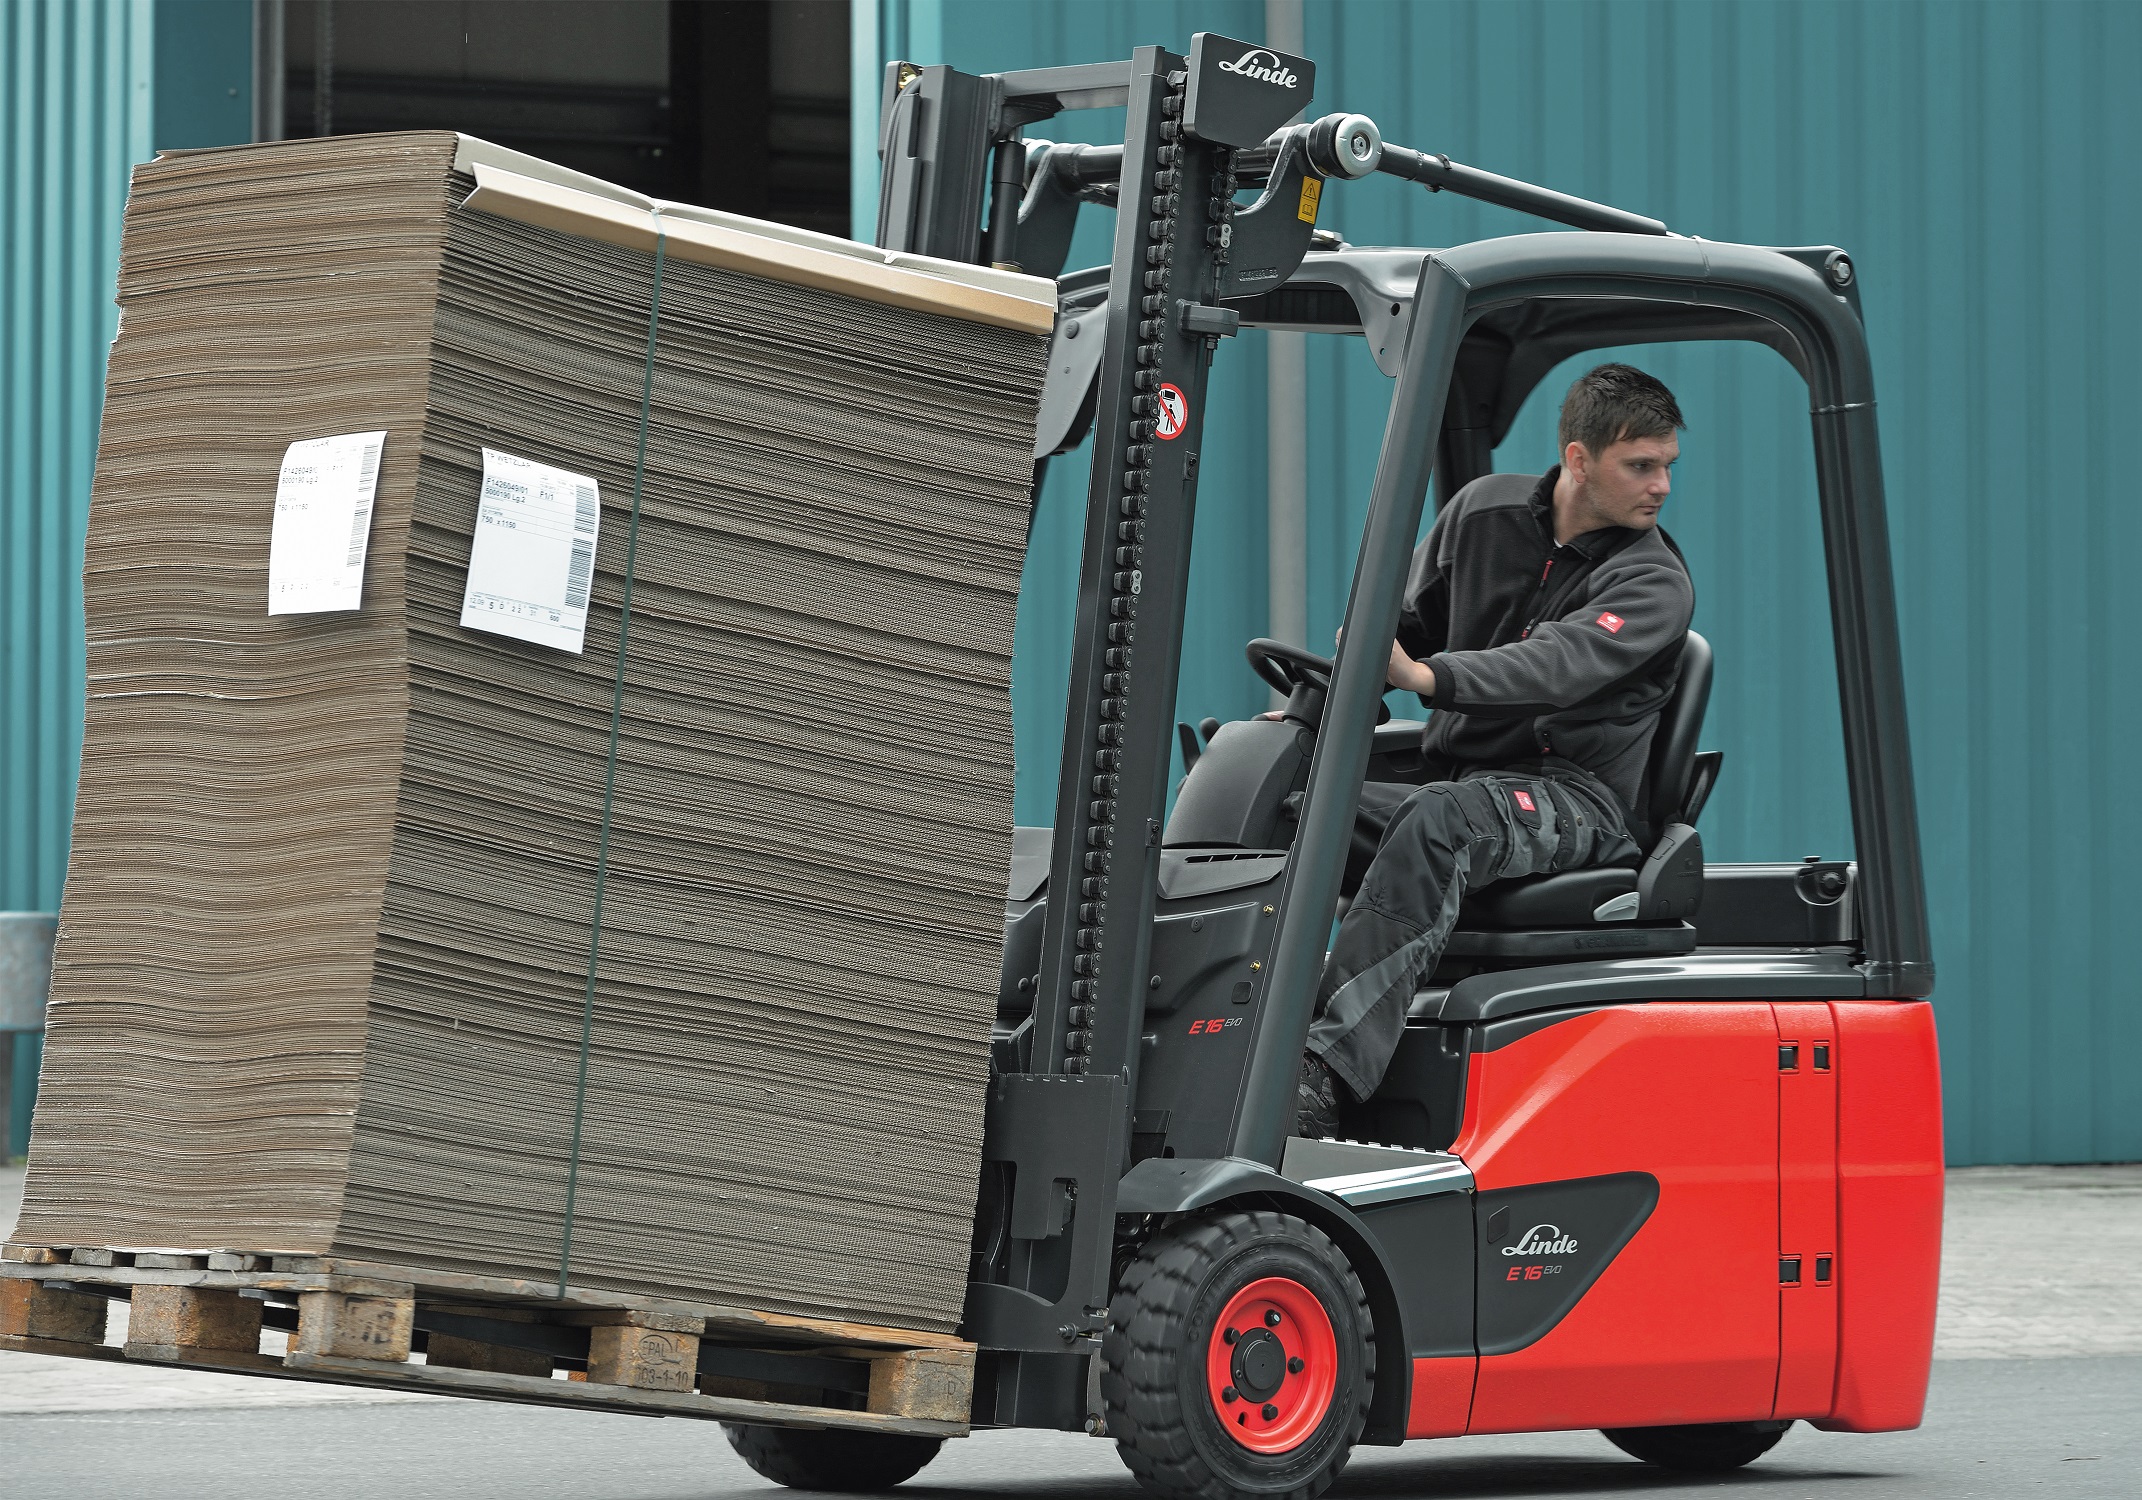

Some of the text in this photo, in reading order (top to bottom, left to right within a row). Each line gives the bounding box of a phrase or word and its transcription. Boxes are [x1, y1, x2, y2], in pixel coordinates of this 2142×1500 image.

[1218, 49, 1298, 88] Linde
[1188, 1017, 1243, 1035] E 16 EVO
[1501, 1224, 1578, 1256] Linde
[1506, 1265, 1562, 1281] E 16 EVO
[642, 1340, 667, 1358] EPAL
